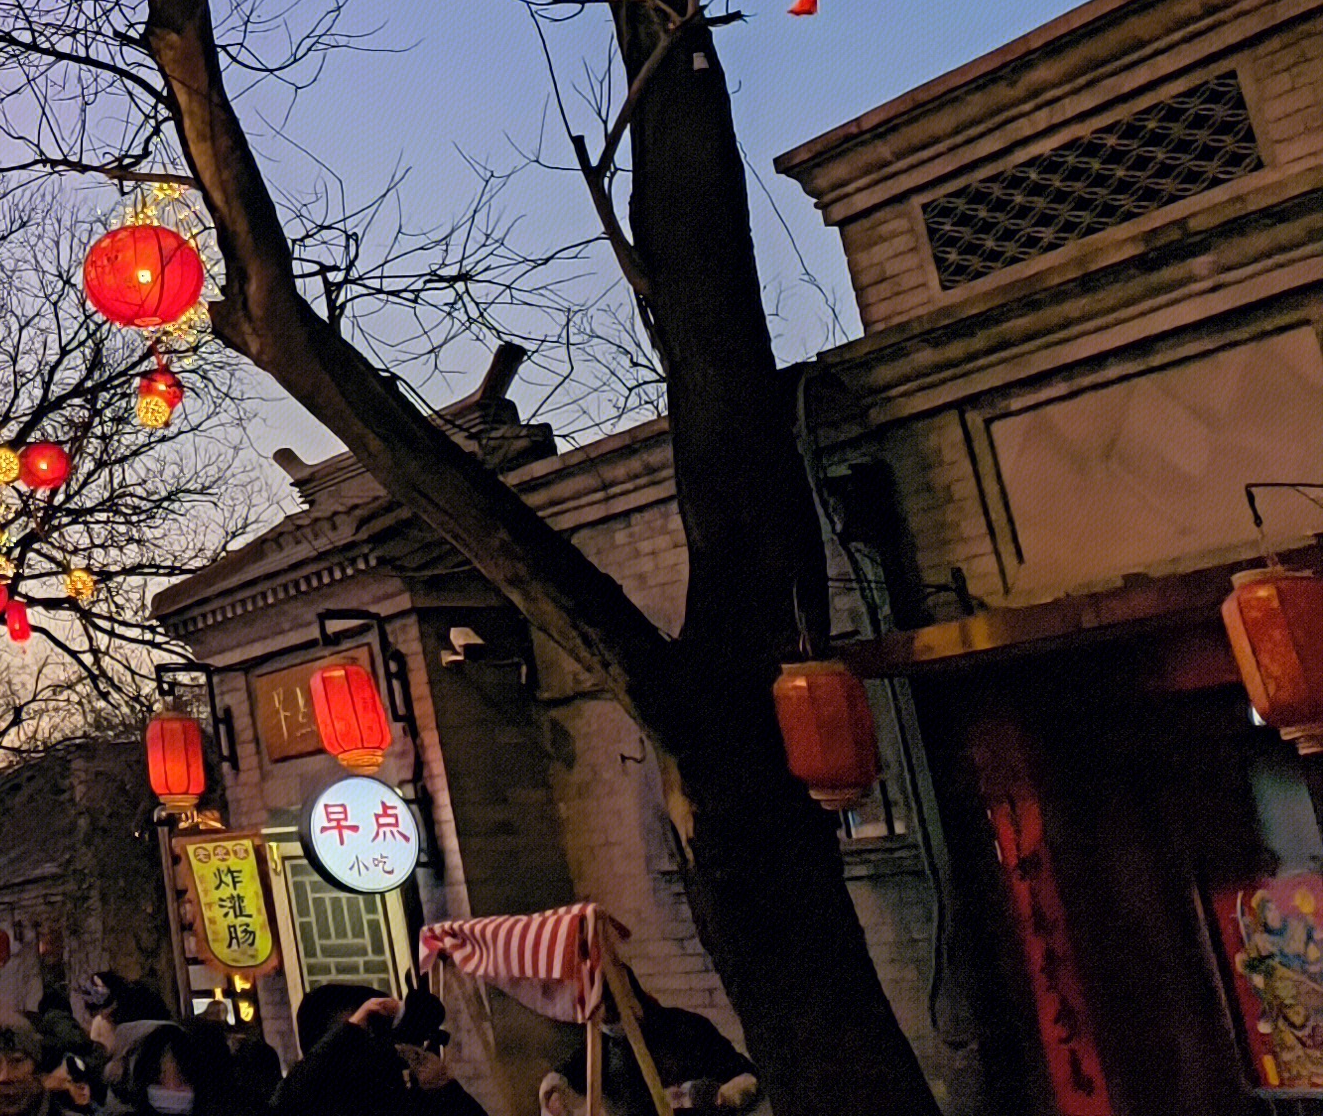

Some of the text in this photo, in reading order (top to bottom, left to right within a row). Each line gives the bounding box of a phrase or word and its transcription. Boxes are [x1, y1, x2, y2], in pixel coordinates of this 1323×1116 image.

[319, 800, 411, 846] 早点
[349, 853, 395, 877] 小吃
[212, 865, 257, 950] 炸灌肠
